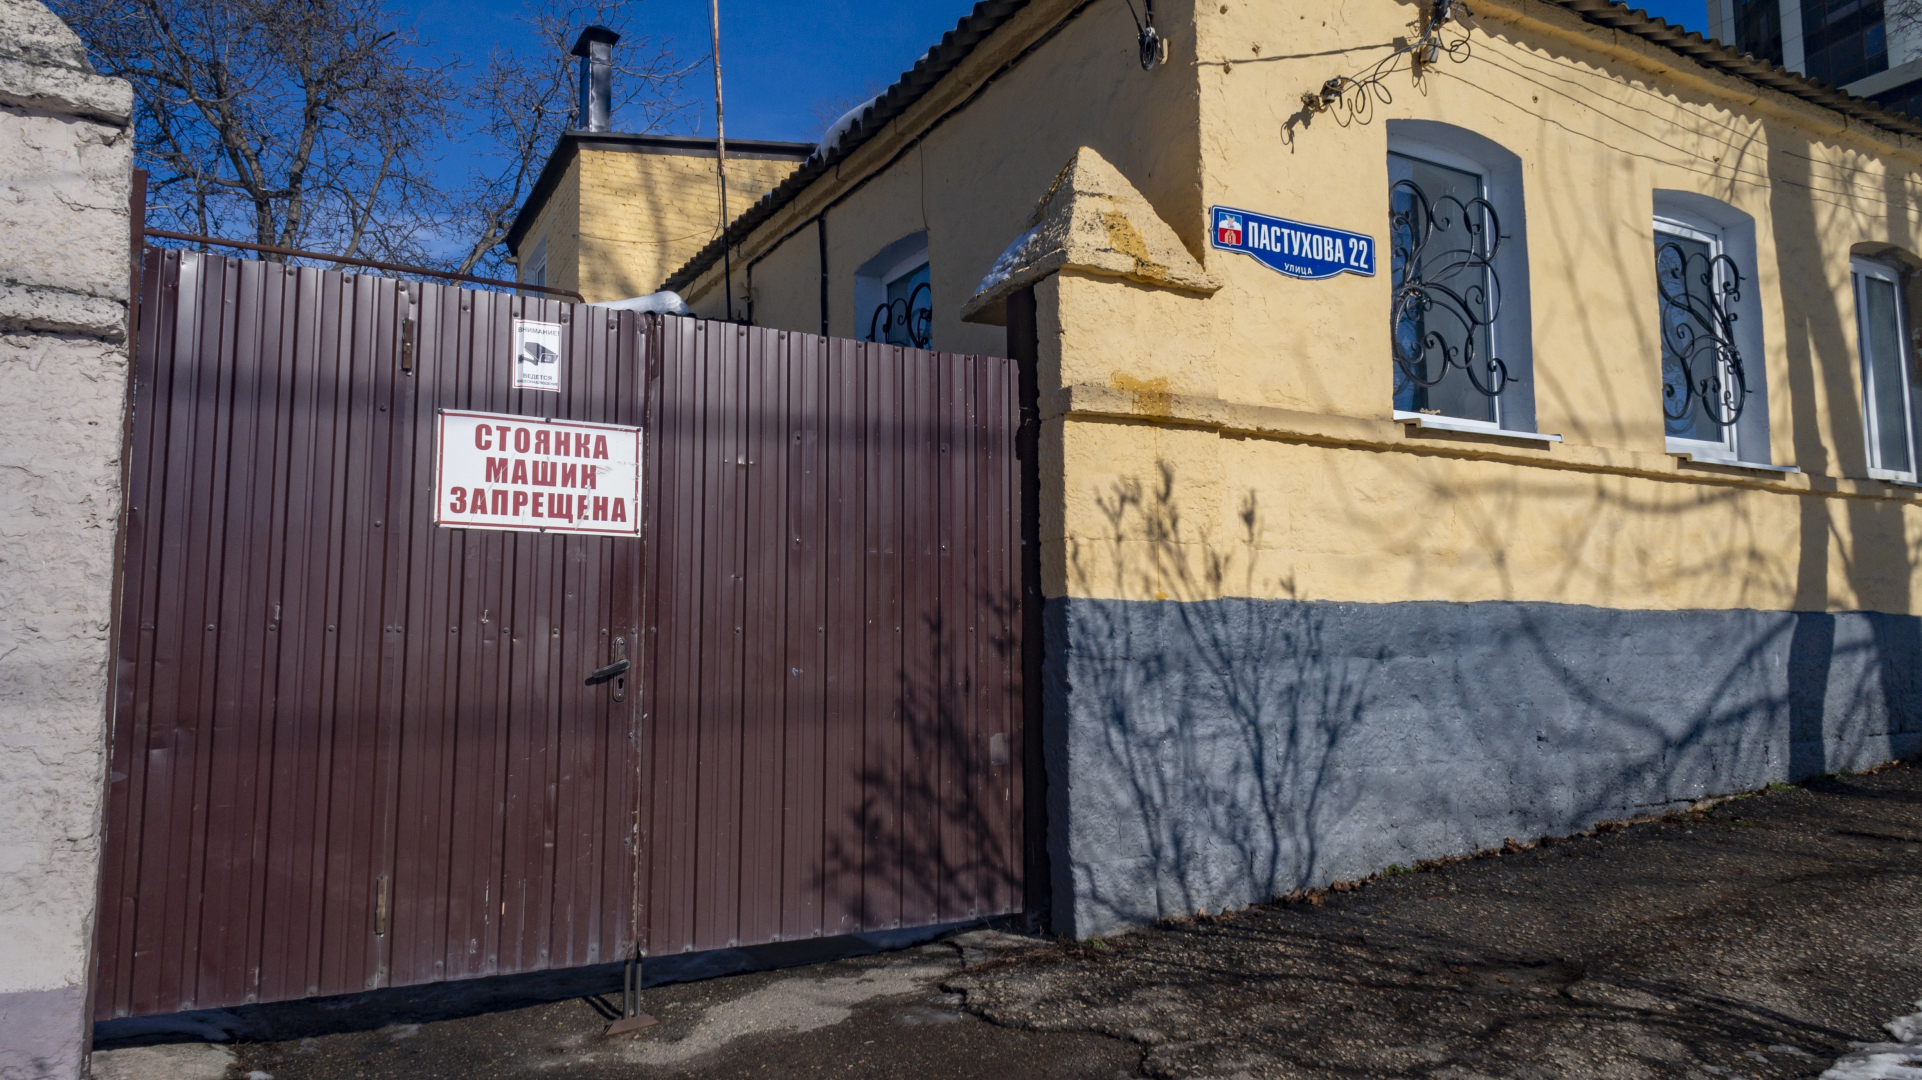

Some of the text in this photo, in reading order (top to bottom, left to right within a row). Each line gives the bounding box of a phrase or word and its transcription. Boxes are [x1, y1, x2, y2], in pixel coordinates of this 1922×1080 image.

[1248, 221, 1369, 269] ПАСТУХОВА 22
[1284, 262, 1313, 275] УЛИЦА
[475, 424, 609, 460] СТОЯНКА
[485, 457, 597, 489] МАШИН
[450, 486, 627, 523] ЗАПРЕЩЕНА
